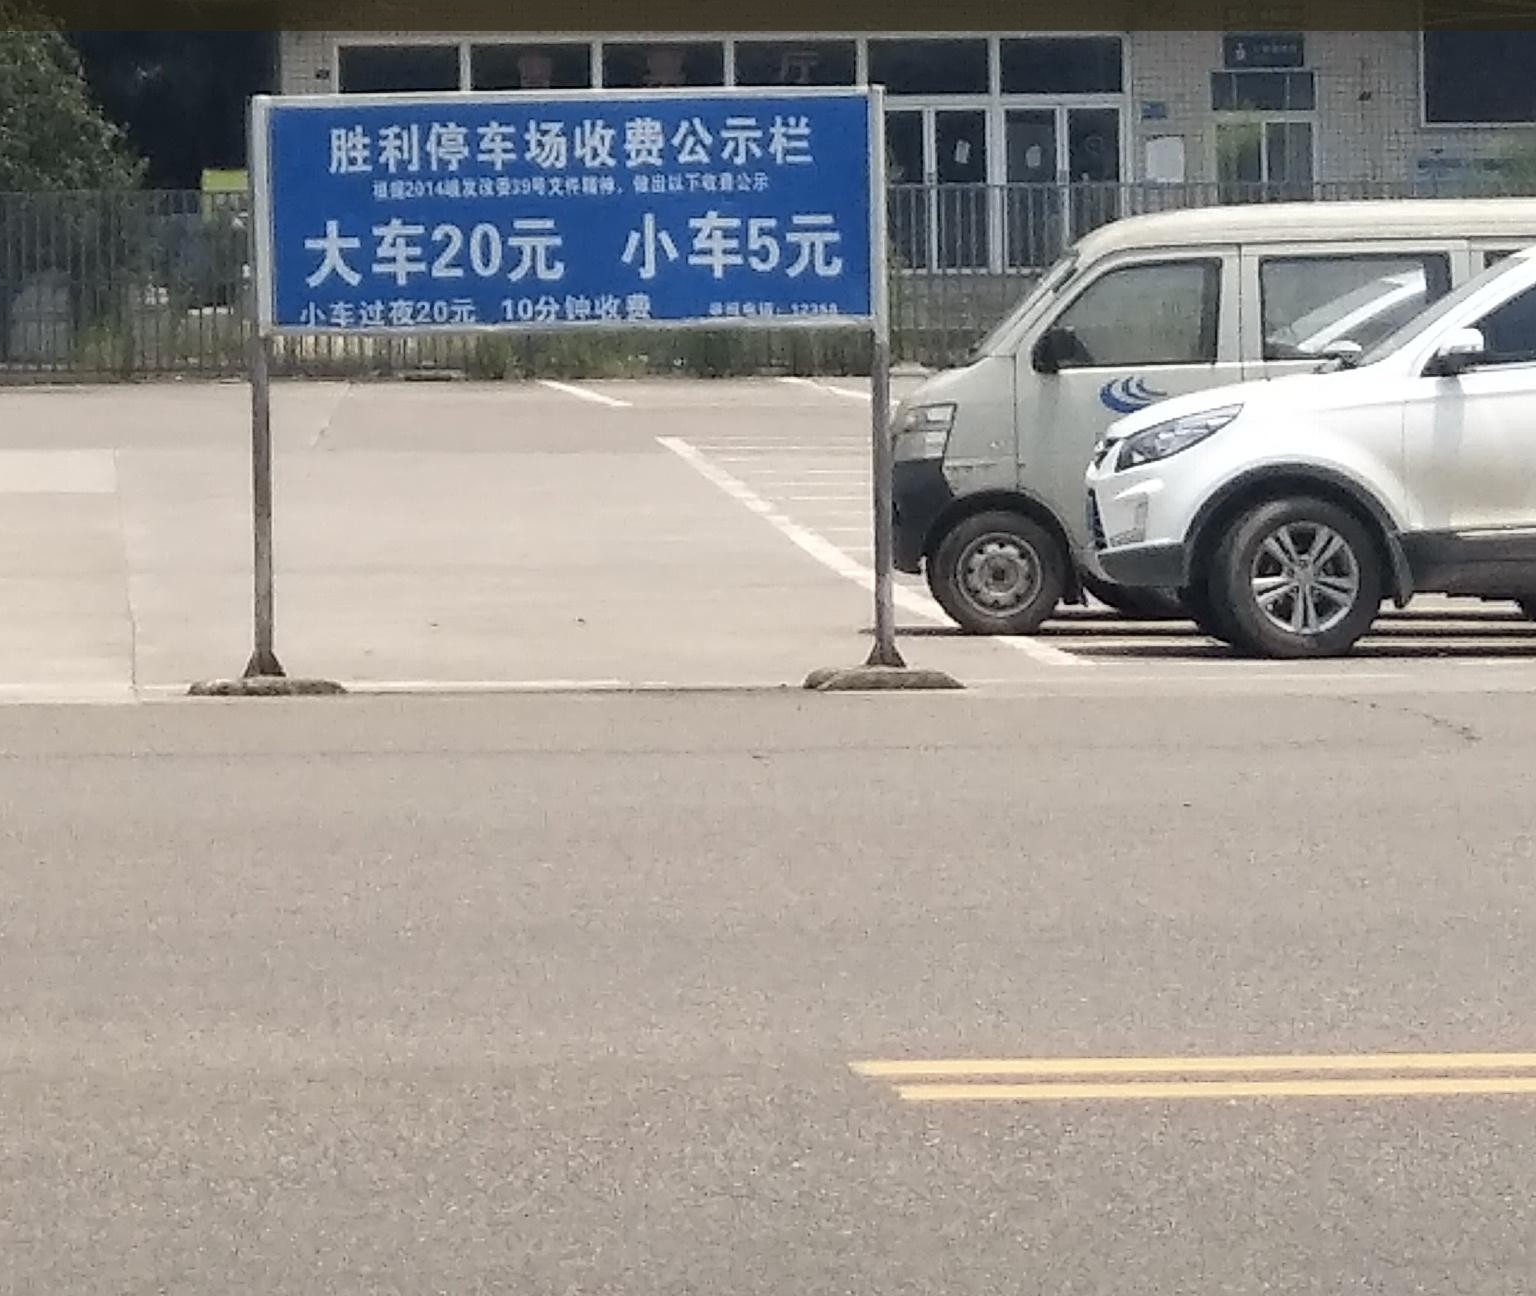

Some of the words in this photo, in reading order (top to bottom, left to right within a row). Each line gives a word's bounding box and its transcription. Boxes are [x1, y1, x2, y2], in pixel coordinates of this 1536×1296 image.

[329, 116, 812, 173] 胜利停车场收费公示栏
[306, 219, 563, 286] 大车20元
[622, 211, 841, 278] 小车5元
[300, 299, 476, 327] 小车过夜20元
[502, 293, 652, 321] 10分钟收费
